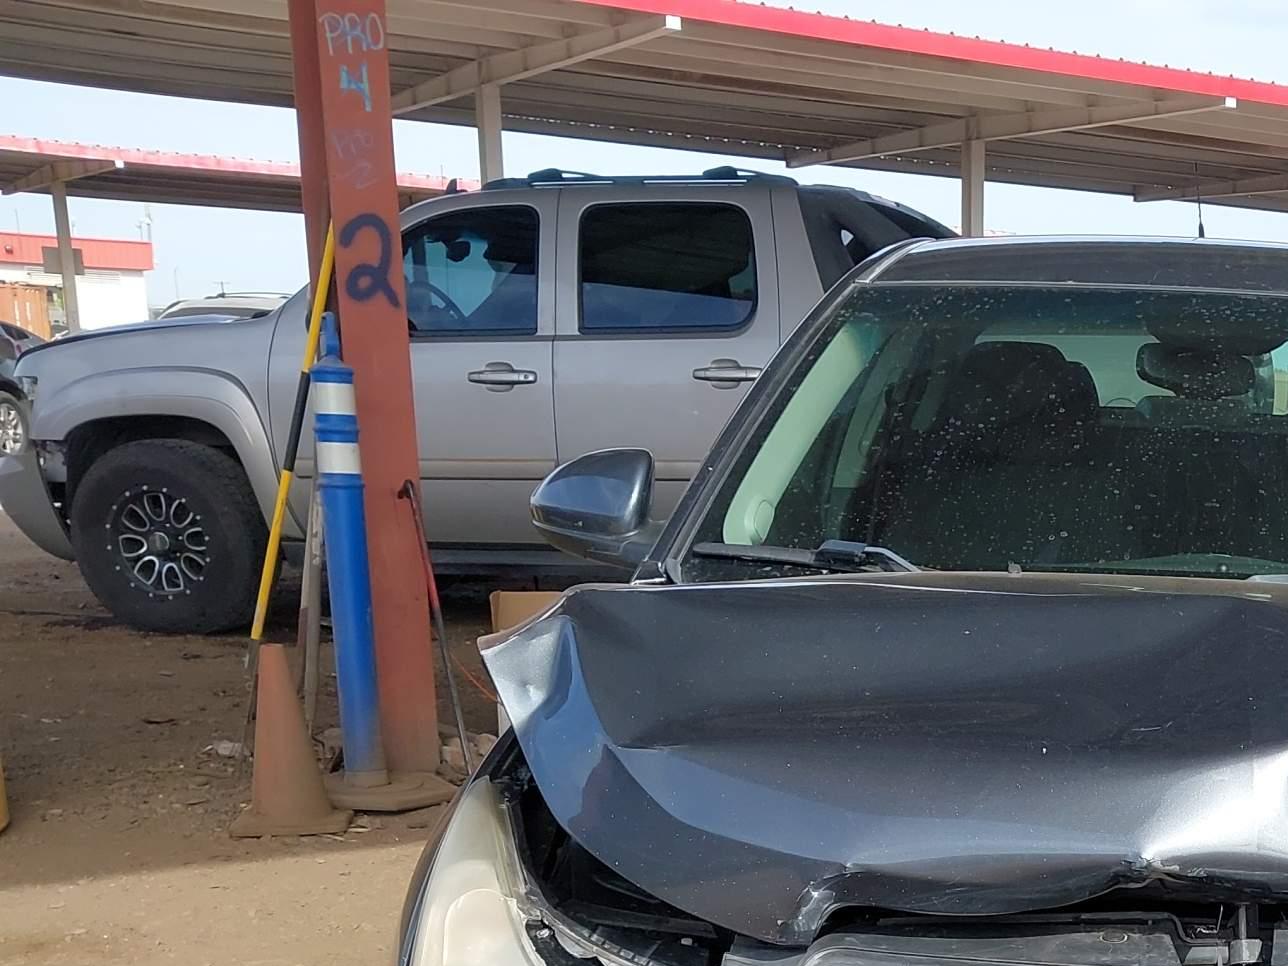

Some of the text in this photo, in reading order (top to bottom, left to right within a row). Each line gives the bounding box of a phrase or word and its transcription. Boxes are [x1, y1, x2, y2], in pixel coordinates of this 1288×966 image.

[319, 12, 386, 55] PRO
[339, 61, 373, 113] 4
[339, 213, 401, 309] 2
